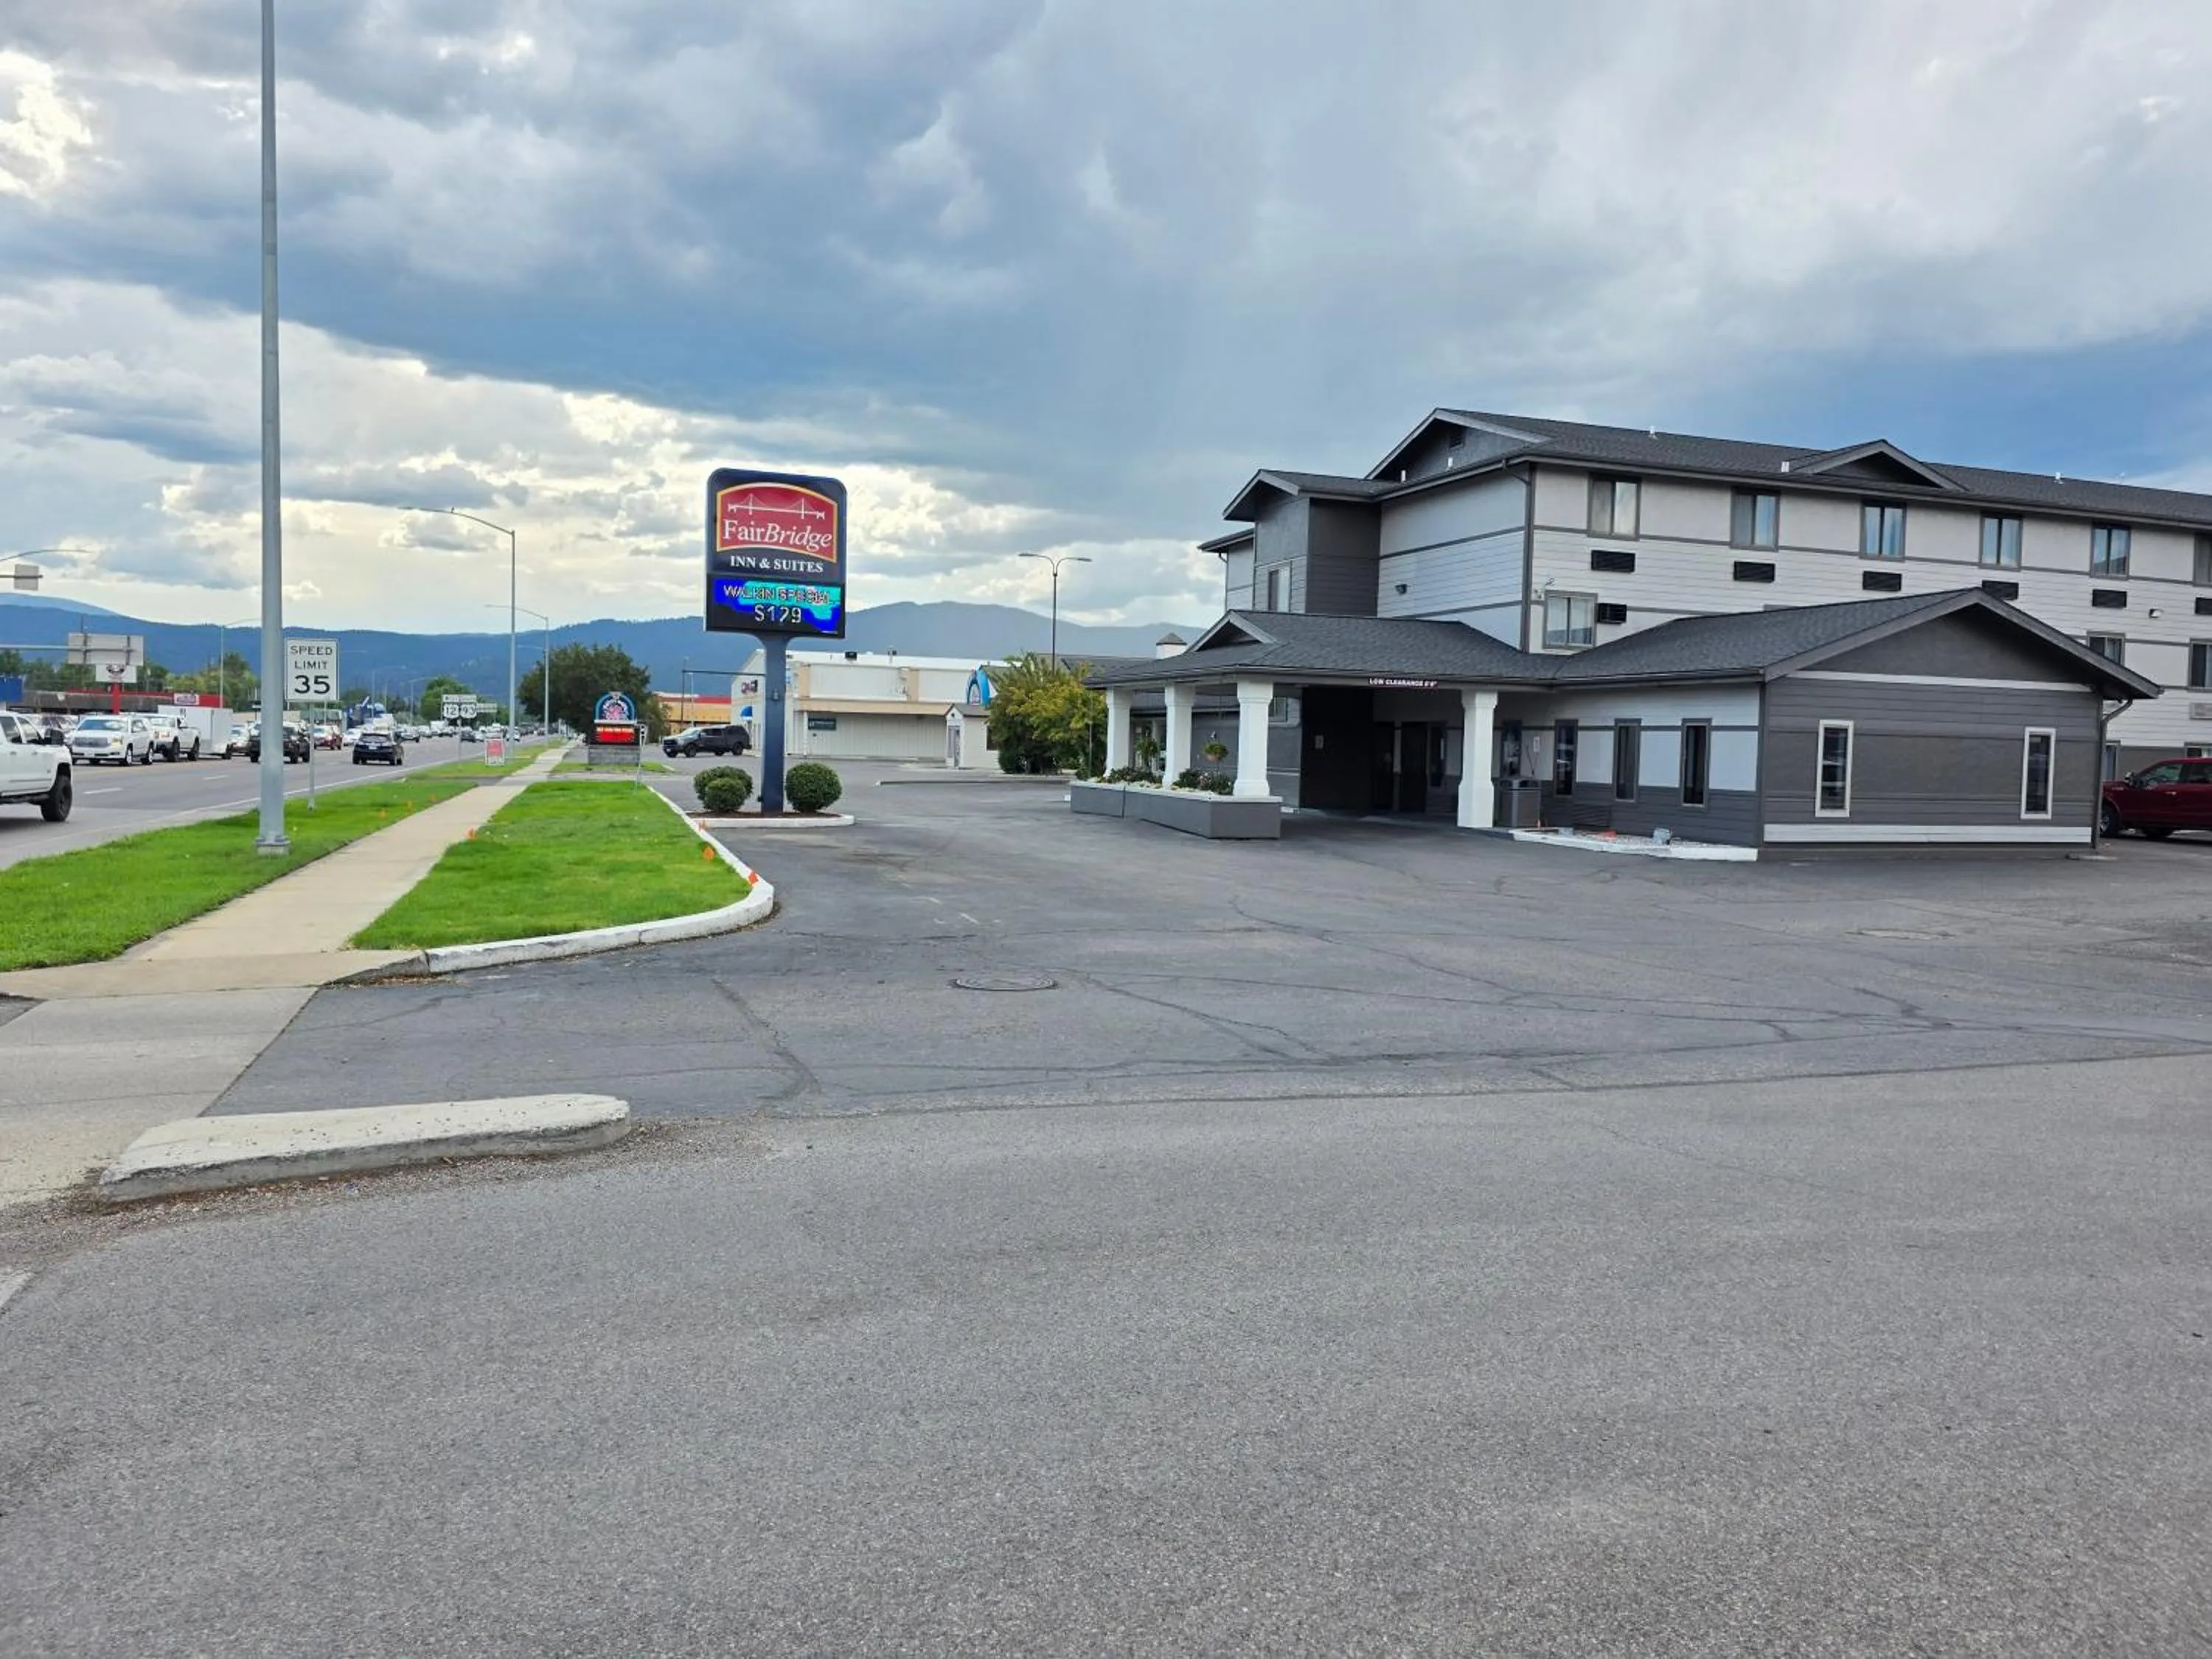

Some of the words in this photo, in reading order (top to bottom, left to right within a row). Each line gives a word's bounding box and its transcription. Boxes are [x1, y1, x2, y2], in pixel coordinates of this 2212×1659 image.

[723, 518, 832, 552] FairBridge
[730, 555, 756, 568] INN
[759, 557, 771, 568] &
[773, 559, 824, 573] SUITES
[290, 645, 333, 655] SPEED
[294, 660, 327, 670] LIMIT
[294, 675, 330, 695] 35
